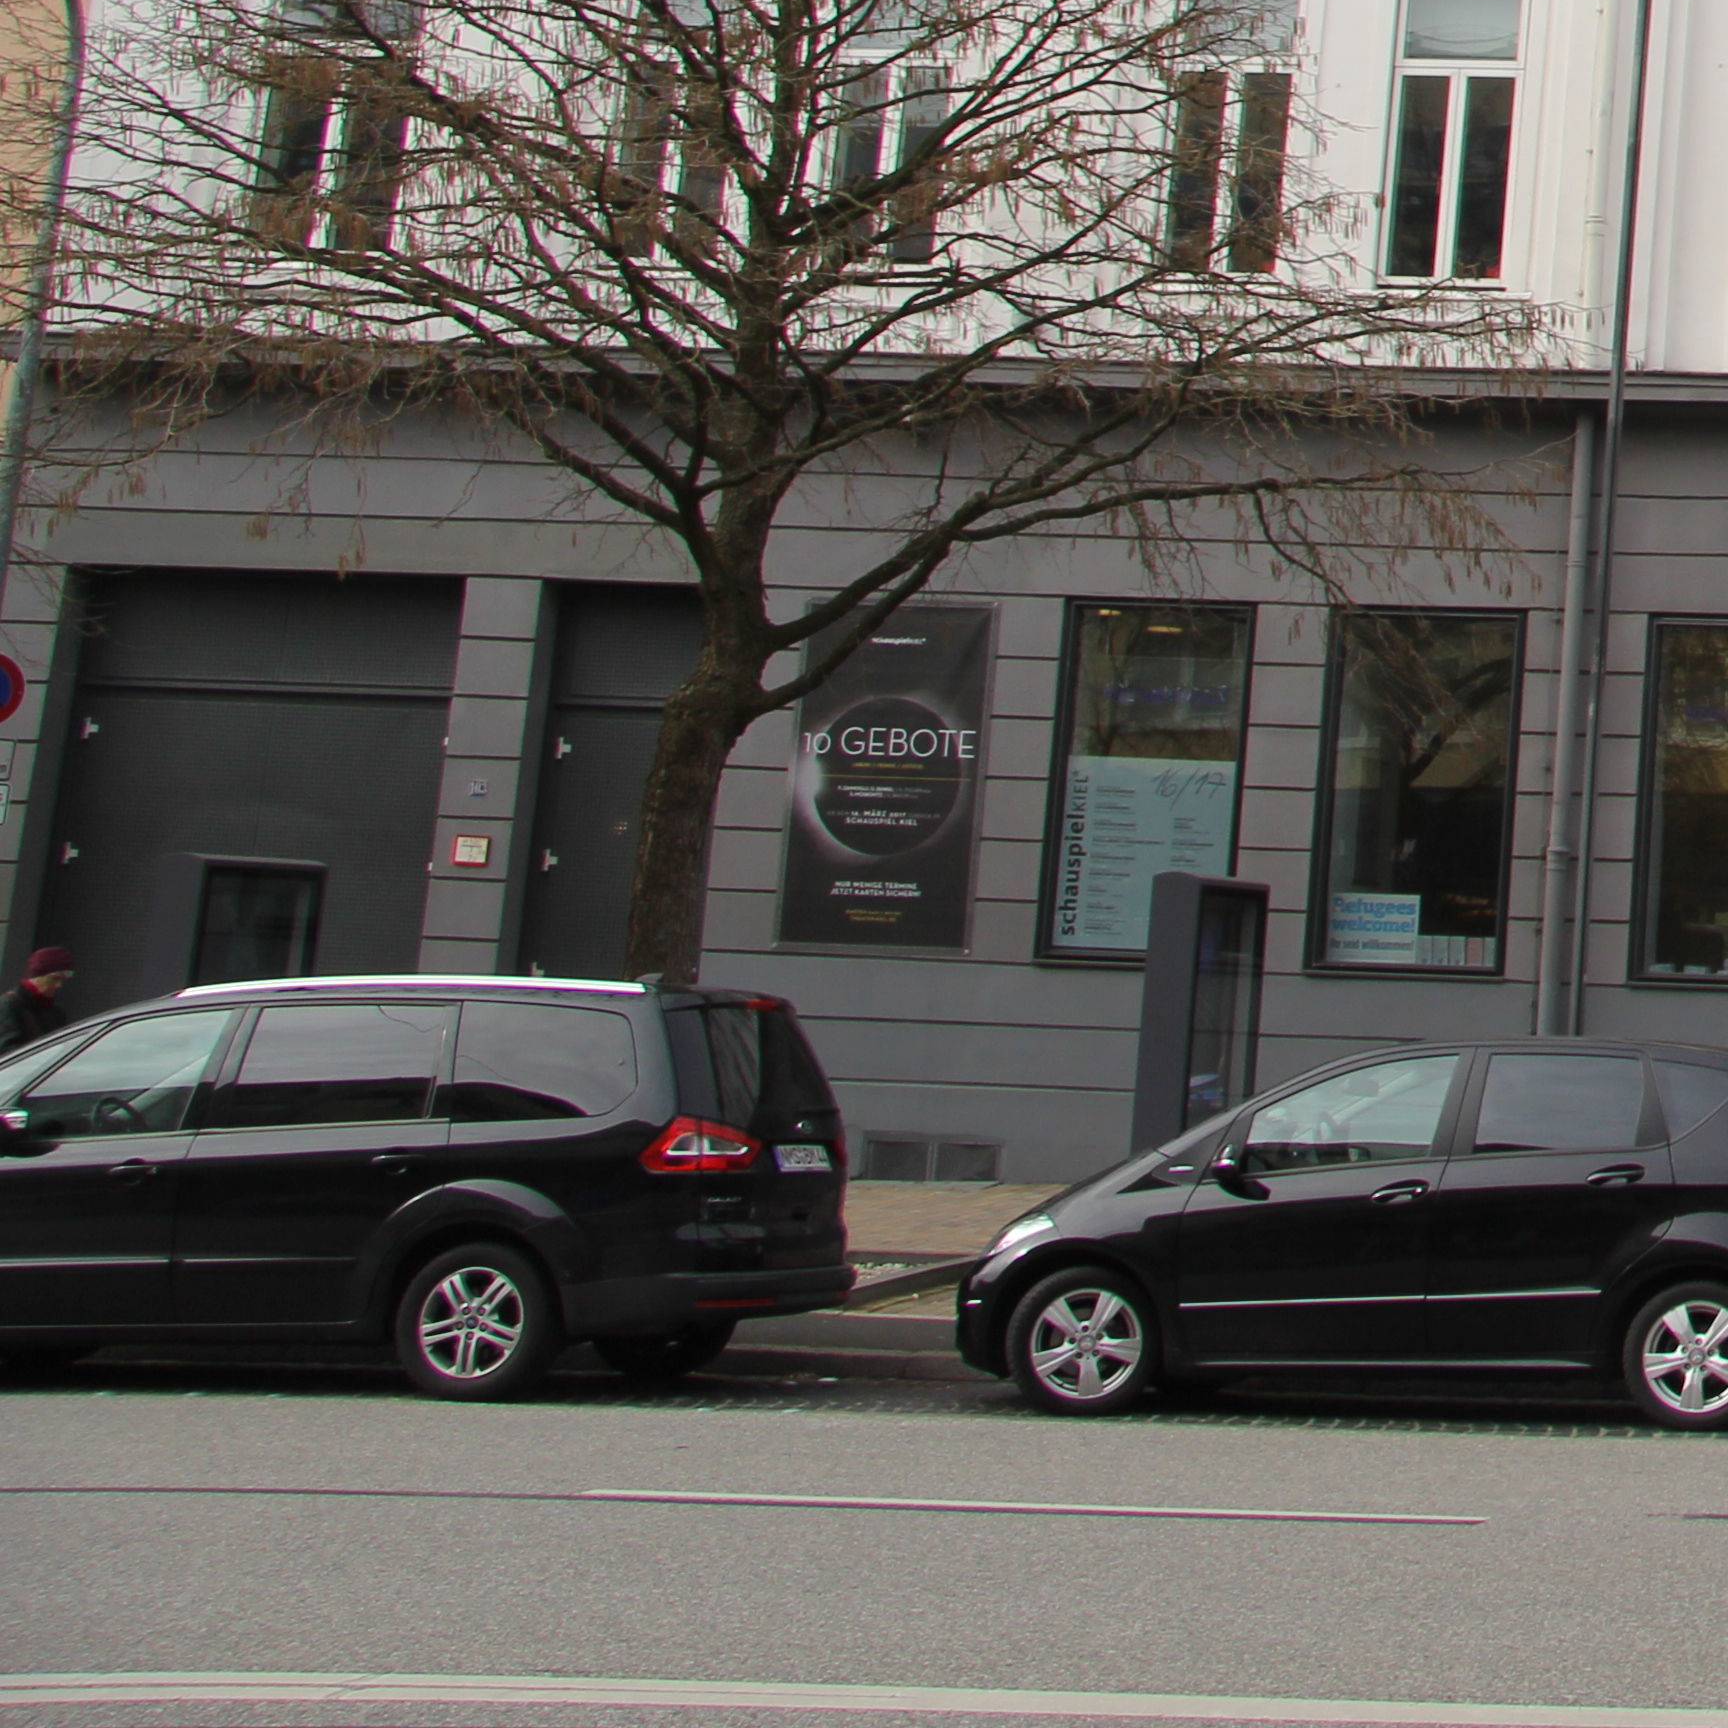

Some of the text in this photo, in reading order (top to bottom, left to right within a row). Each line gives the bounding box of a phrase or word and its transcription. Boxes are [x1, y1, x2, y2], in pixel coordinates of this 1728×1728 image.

[804, 726, 976, 759] 10 GEBOTE
[1152, 767, 1227, 811] 16/17
[845, 817, 896, 825] SCHAUSPIEL
[1331, 896, 1416, 918] Refugees
[1330, 917, 1415, 933] welcome!
